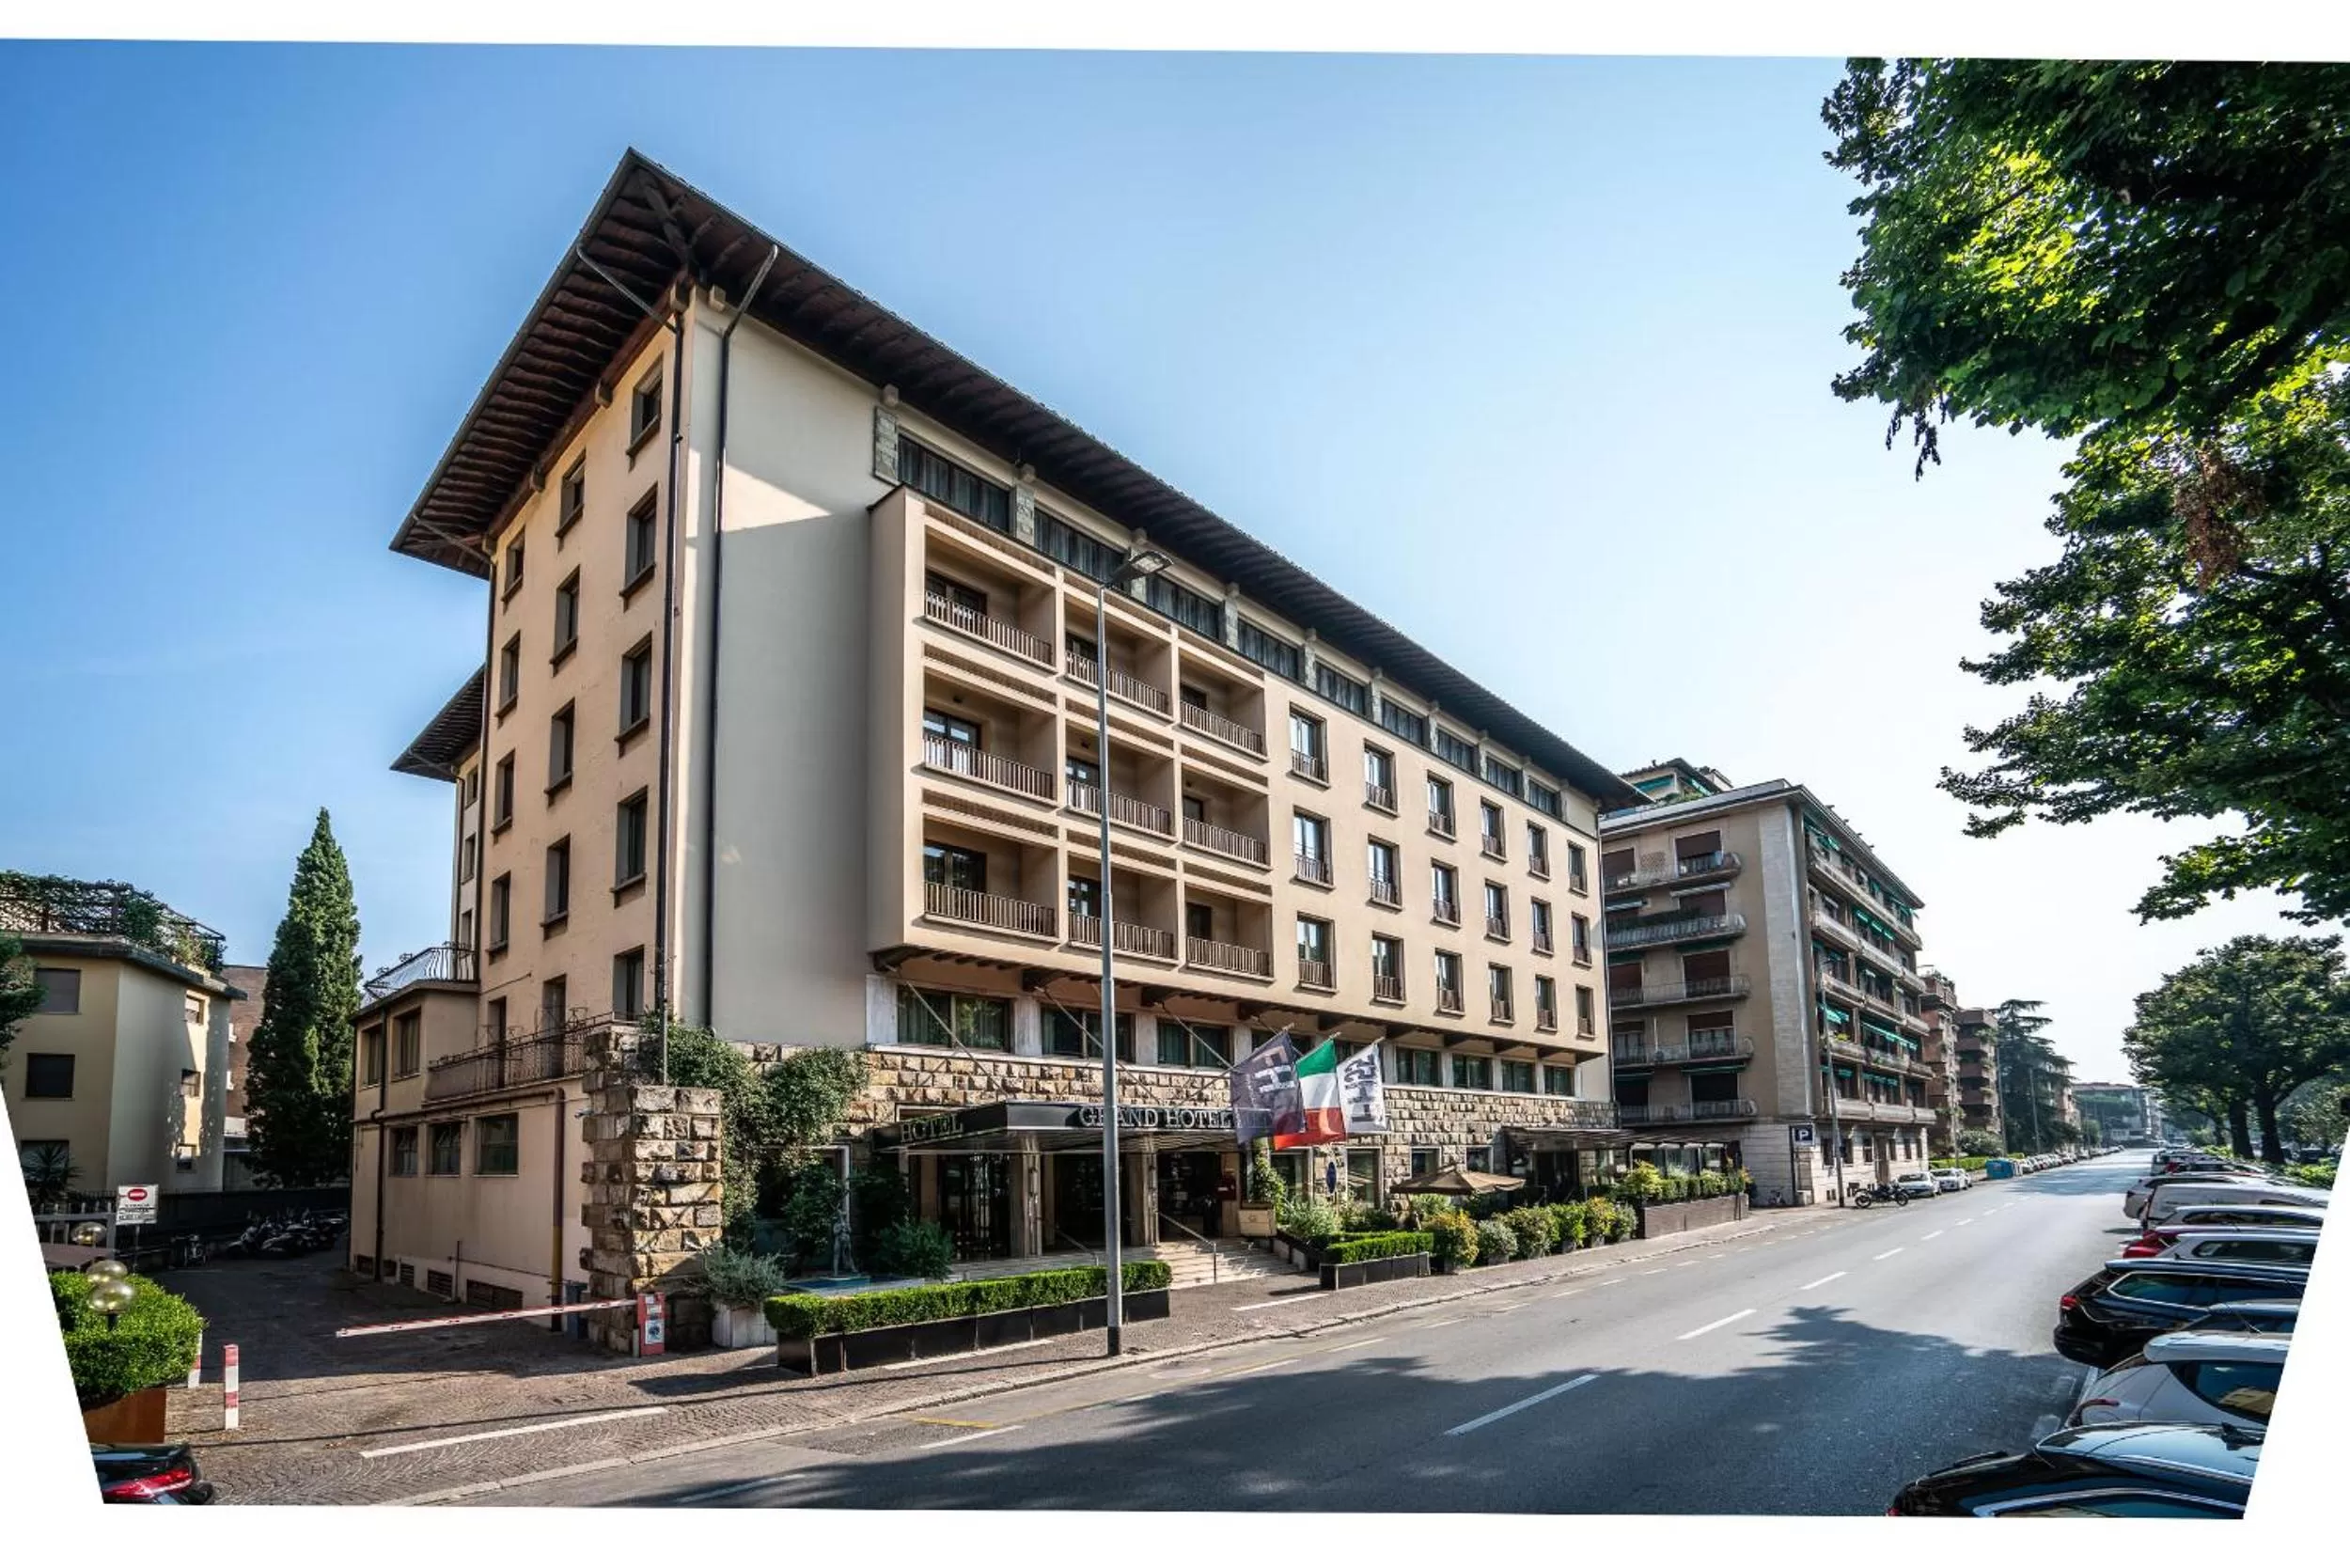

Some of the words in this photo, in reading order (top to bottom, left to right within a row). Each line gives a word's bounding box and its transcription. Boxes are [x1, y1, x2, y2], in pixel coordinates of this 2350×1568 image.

[901, 1113, 964, 1143] HOTEL
[1165, 1108, 1233, 1129] HOTEL
[1797, 1129, 1810, 1141] P
